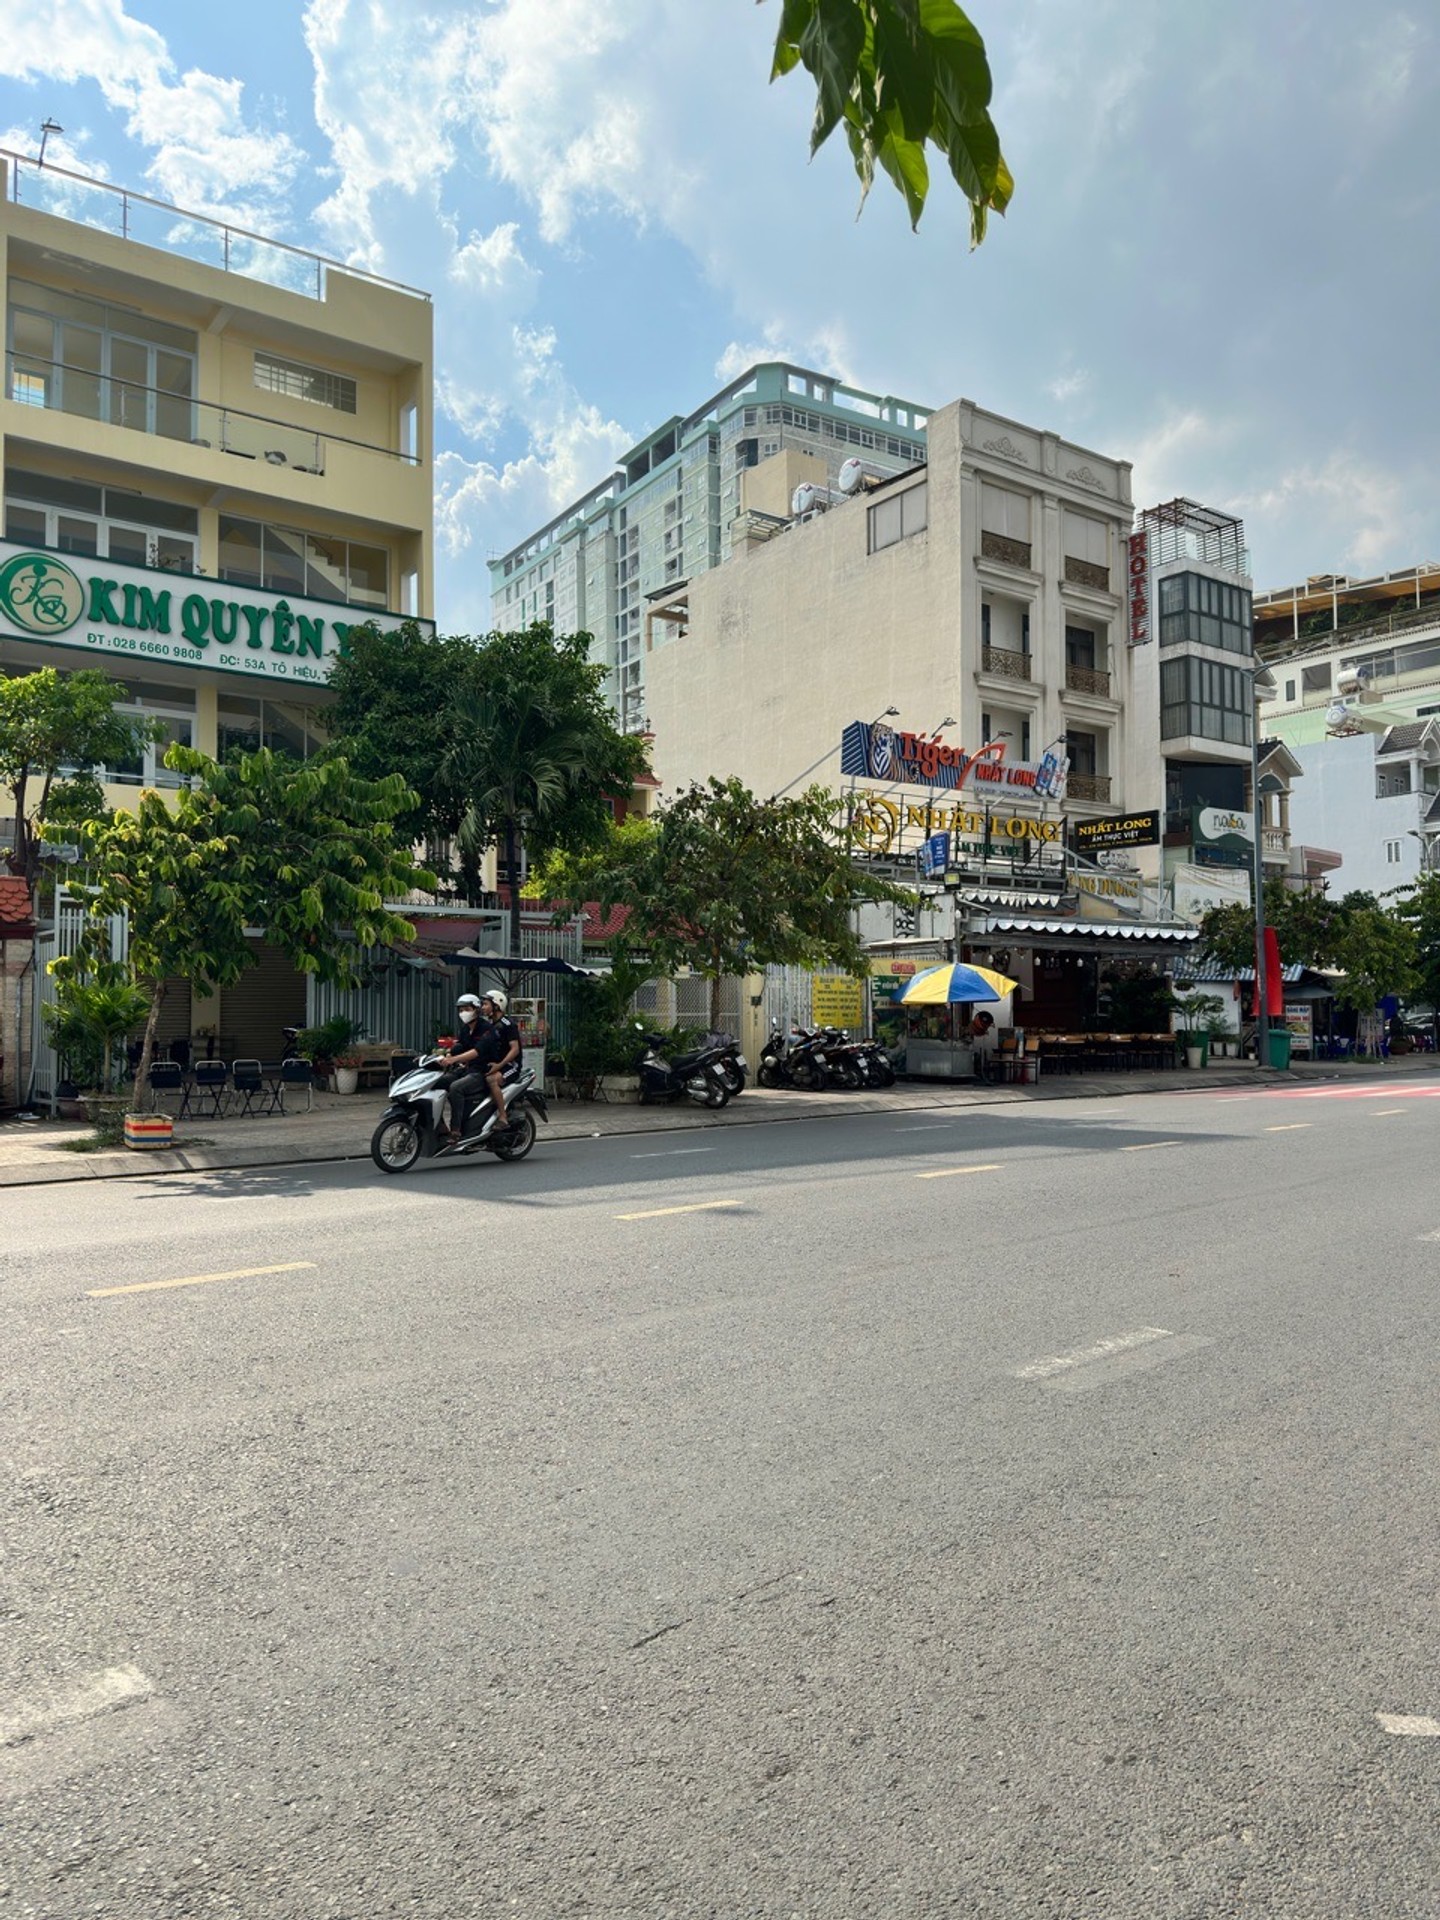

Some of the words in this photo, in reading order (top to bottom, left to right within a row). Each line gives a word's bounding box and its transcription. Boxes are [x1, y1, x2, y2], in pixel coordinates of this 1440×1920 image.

[1128, 531, 1148, 641] HOTEL
[87, 577, 172, 634] KIM
[181, 594, 326, 660] QUYÊN
[113, 637, 136, 649] 028
[139, 641, 170, 655] 6660
[173, 646, 203, 660] 9808
[244, 658, 266, 671] 53A
[900, 731, 966, 778] Tiger
[1007, 767, 1036, 788] LONG
[990, 816, 1060, 842] LONG
[1078, 820, 1113, 836] NHẤT
[1116, 817, 1152, 831] LONG
